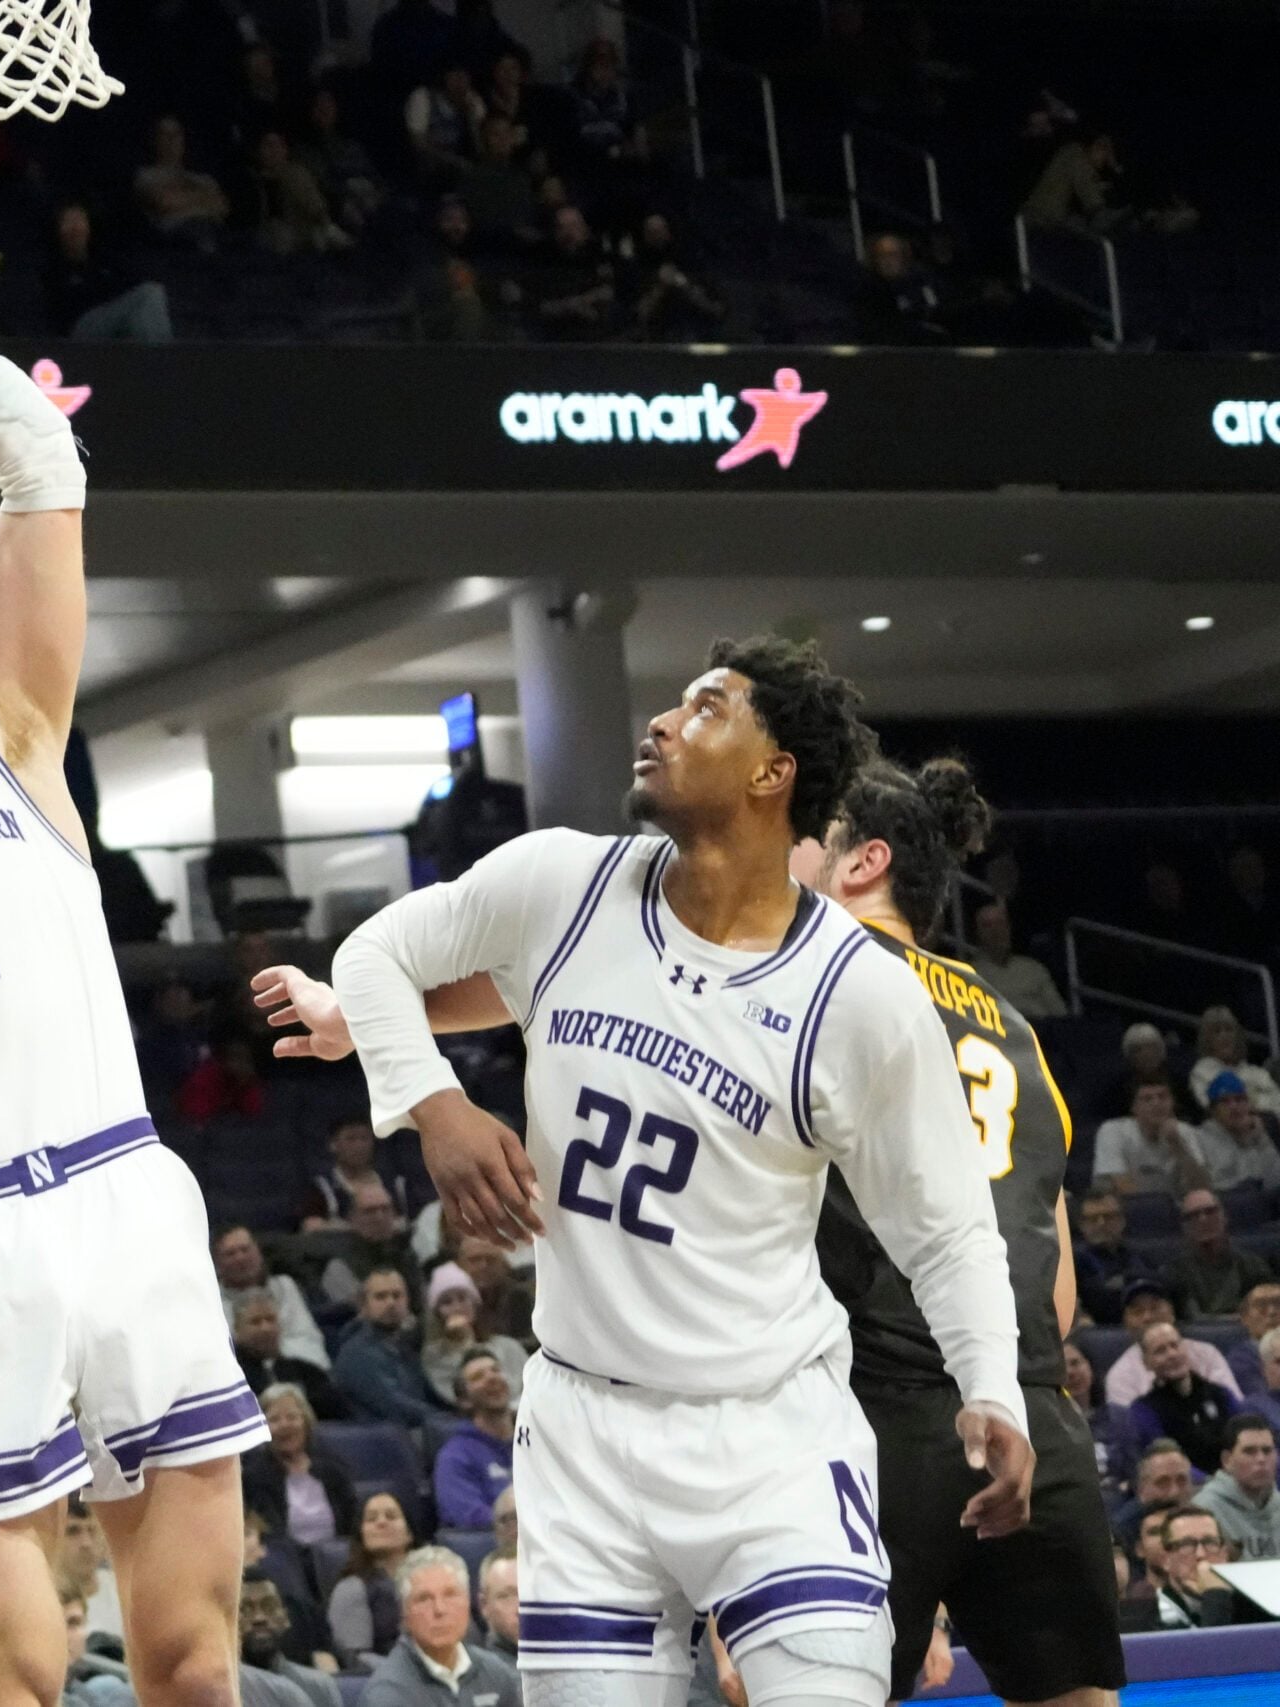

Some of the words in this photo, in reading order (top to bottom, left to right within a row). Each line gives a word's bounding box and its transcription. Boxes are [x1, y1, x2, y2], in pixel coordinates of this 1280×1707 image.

[499, 382, 740, 443] aramark
[547, 1009, 772, 1137] NORTHWESTERN
[25, 1149, 56, 1189] N
[558, 1085, 700, 1247] 22
